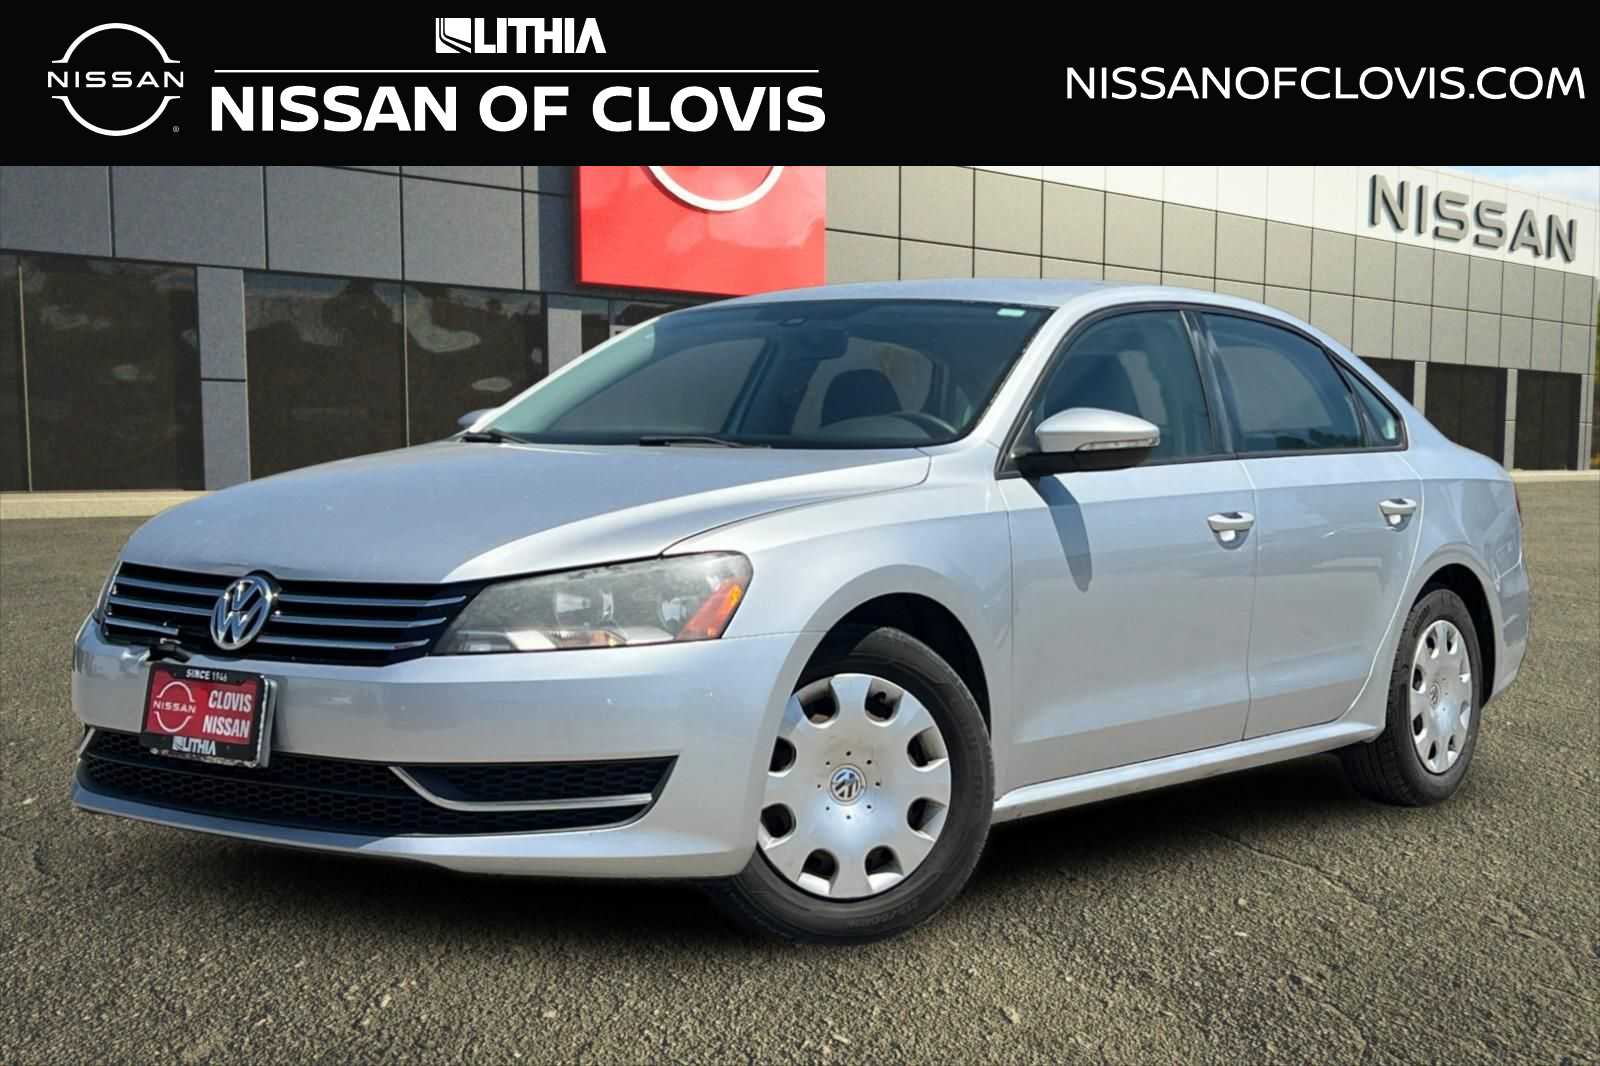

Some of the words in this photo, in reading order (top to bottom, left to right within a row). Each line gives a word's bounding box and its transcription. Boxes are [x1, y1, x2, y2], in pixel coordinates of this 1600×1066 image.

[1369, 173, 1578, 263] NISSAN
[153, 700, 196, 714] NISSAN
[208, 690, 253, 713] CLOVIS
[202, 714, 250, 738] NISSAN
[183, 737, 217, 756] LITHIA
